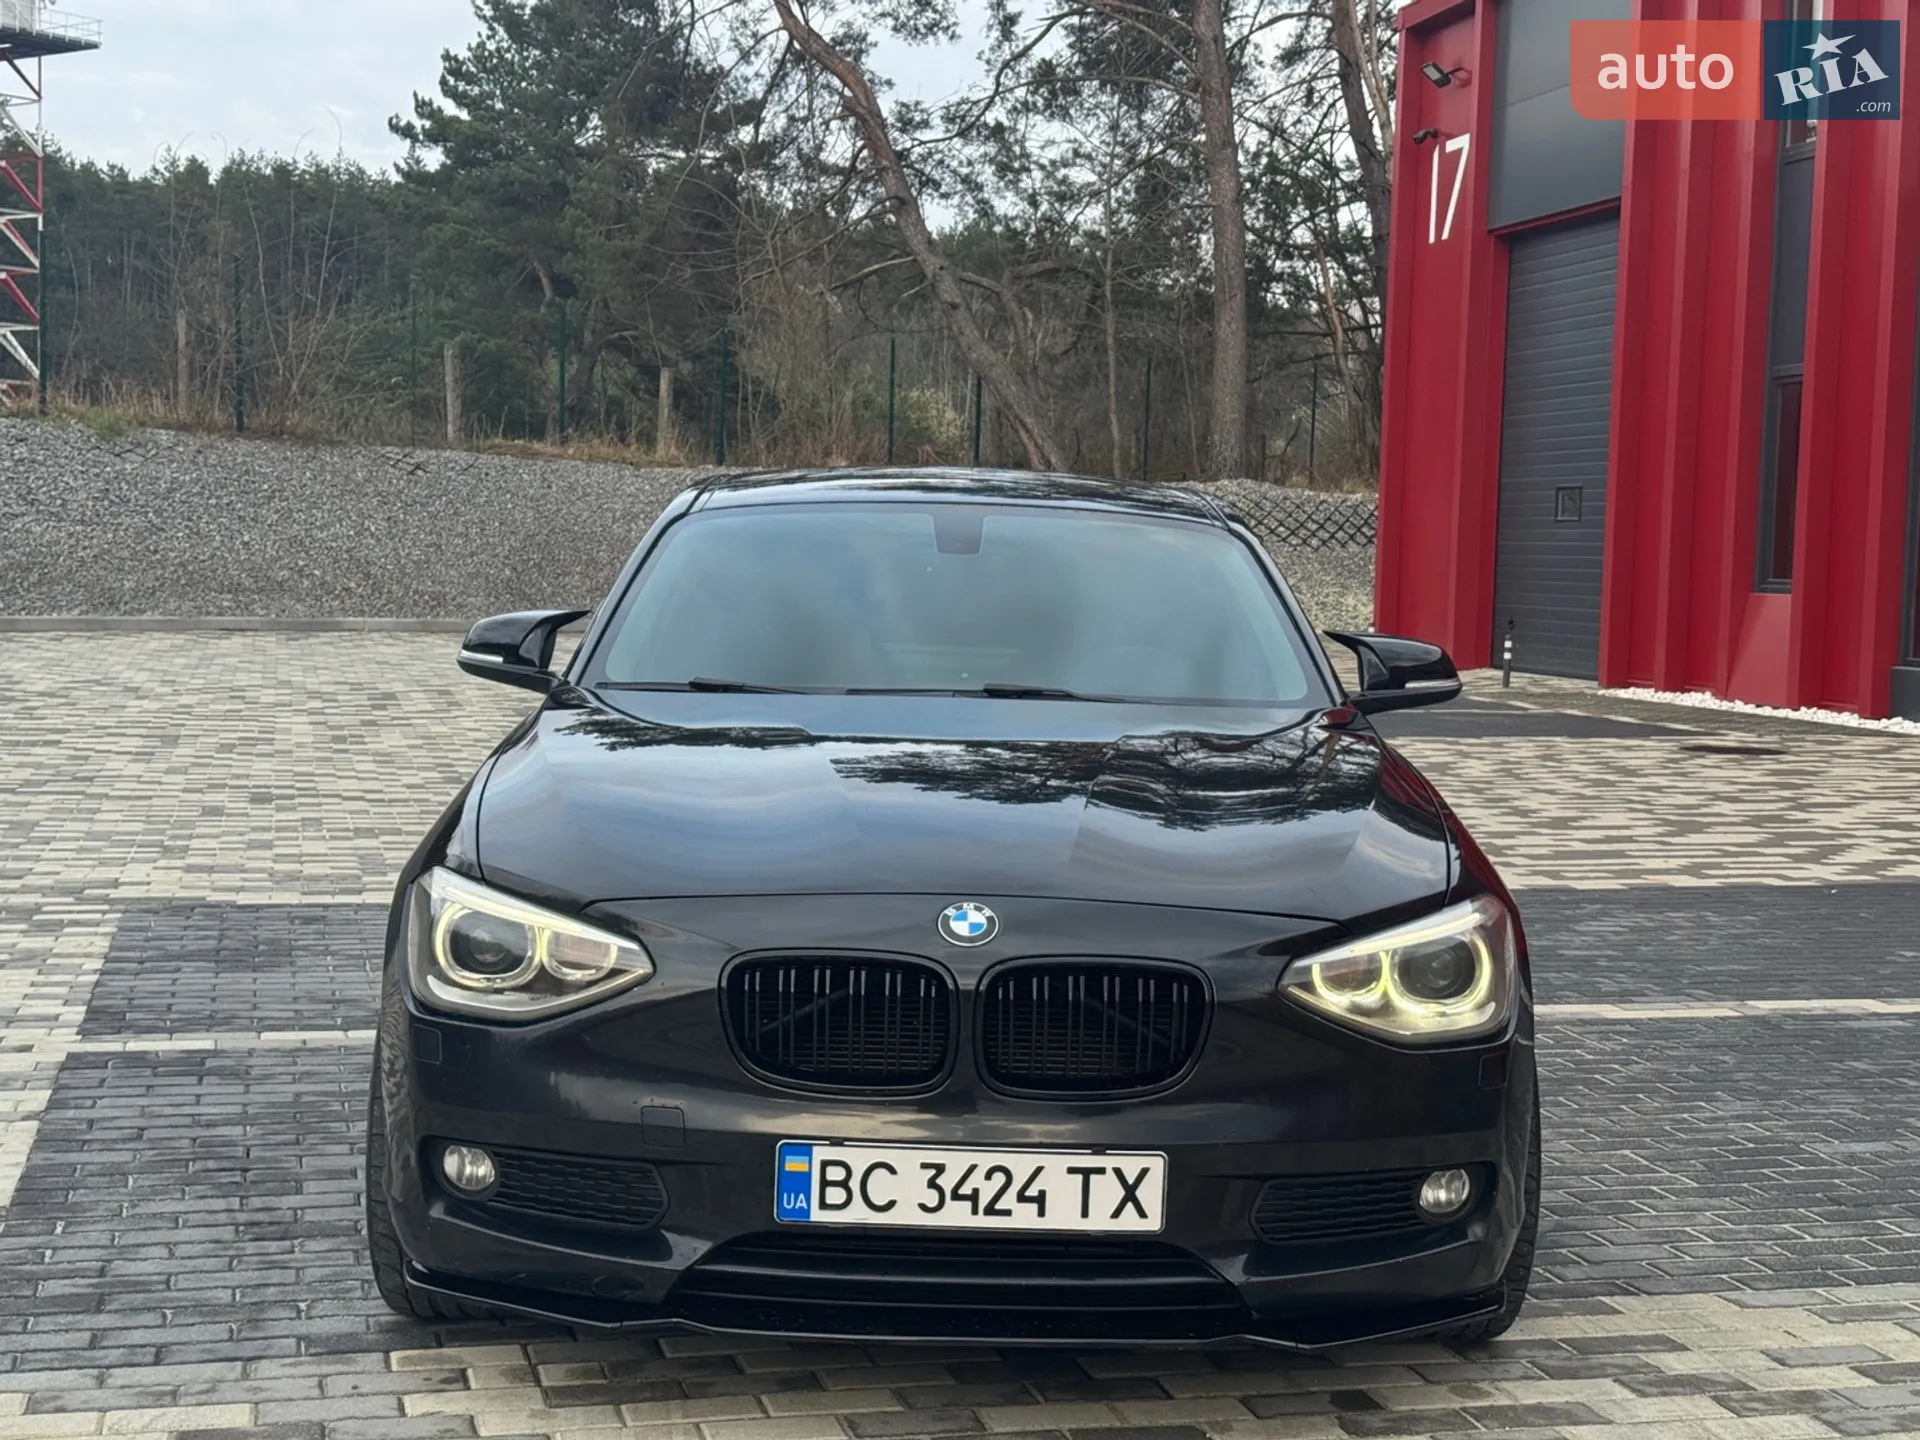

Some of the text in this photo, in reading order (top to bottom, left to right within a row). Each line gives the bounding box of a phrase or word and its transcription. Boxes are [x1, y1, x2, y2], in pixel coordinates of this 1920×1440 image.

[1428, 133, 1471, 244] 17
[783, 1193, 808, 1210] UA
[817, 1158, 1151, 1219] BC 3424 TX
